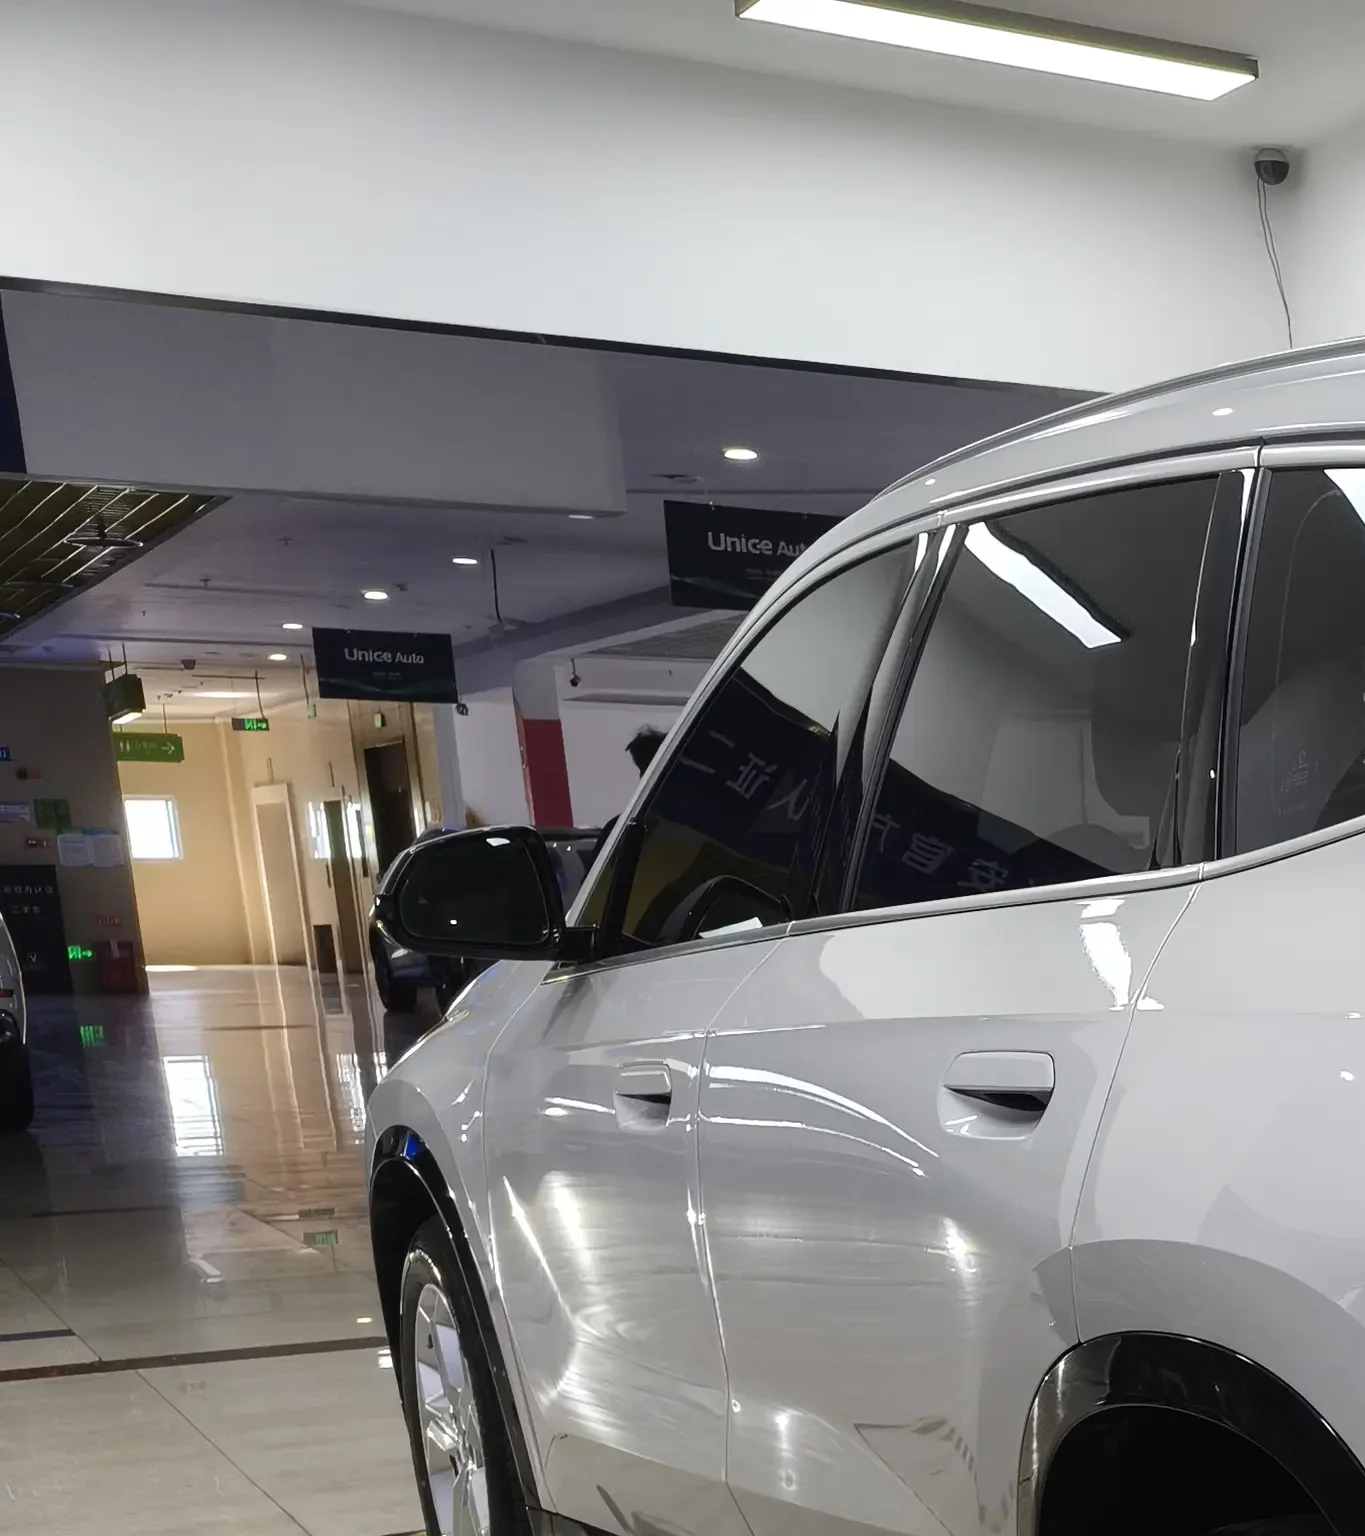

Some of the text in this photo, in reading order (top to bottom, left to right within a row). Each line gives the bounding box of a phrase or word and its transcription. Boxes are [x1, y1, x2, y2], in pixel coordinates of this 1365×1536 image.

[708, 532, 806, 557] Unice Aut
[344, 648, 424, 664] Unice Auto
